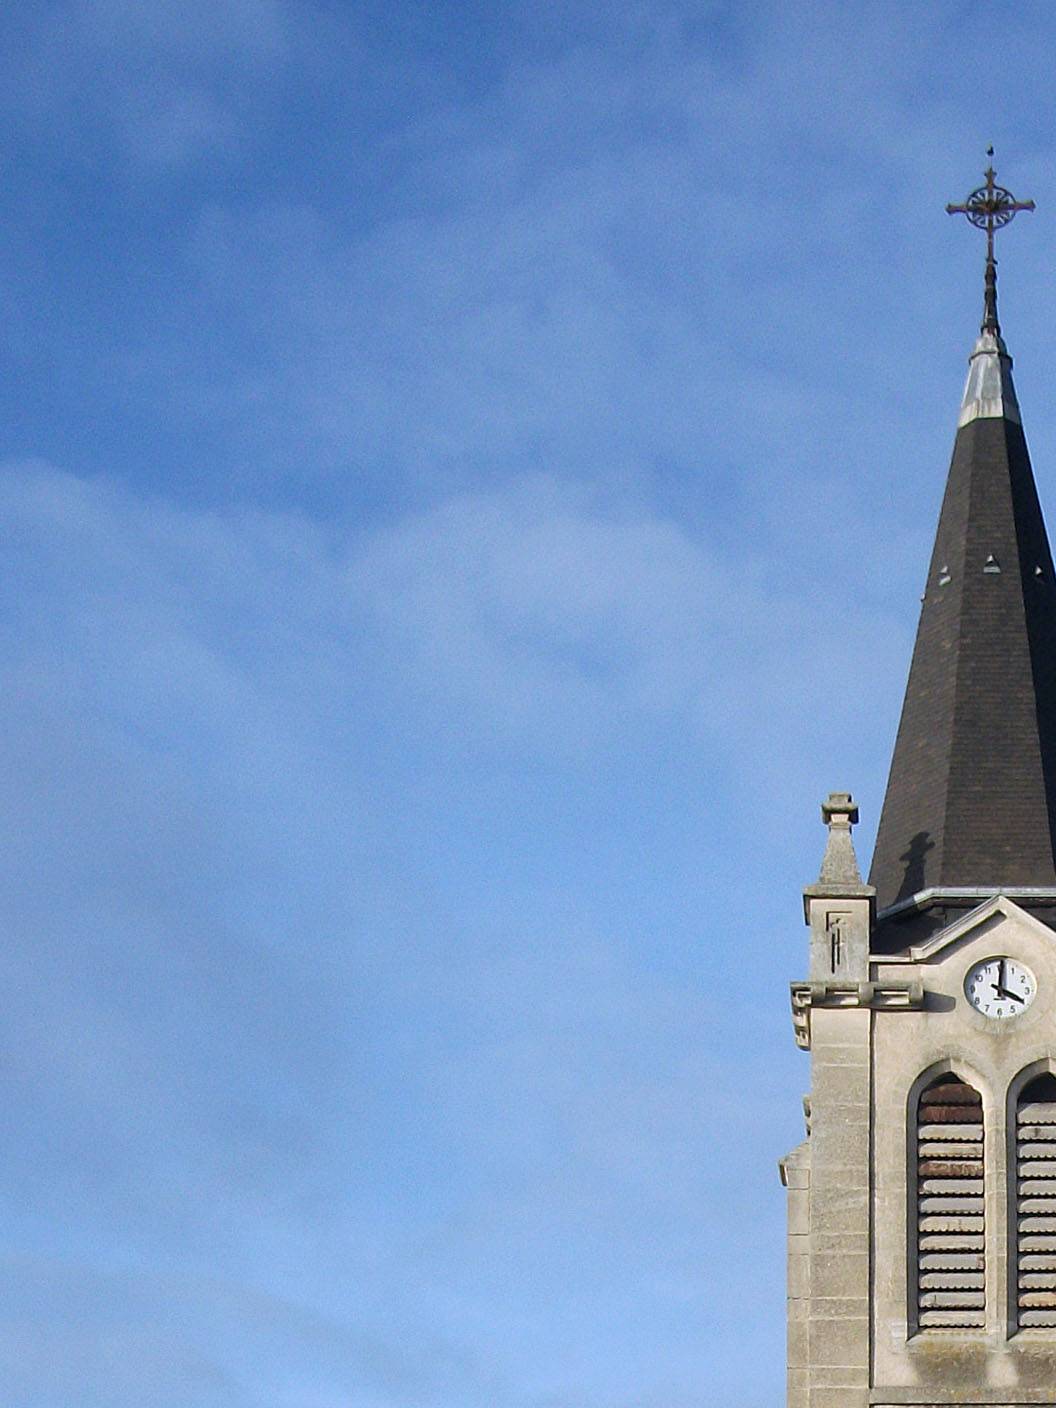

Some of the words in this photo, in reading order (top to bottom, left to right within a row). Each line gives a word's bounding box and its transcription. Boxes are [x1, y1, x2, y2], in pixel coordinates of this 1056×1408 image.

[1025, 987, 1030, 995] 3
[974, 997, 980, 1005] 8
[984, 1004, 990, 1012] 7
[997, 1008, 1003, 1016] 6
[1010, 1005, 1016, 1013] 5
